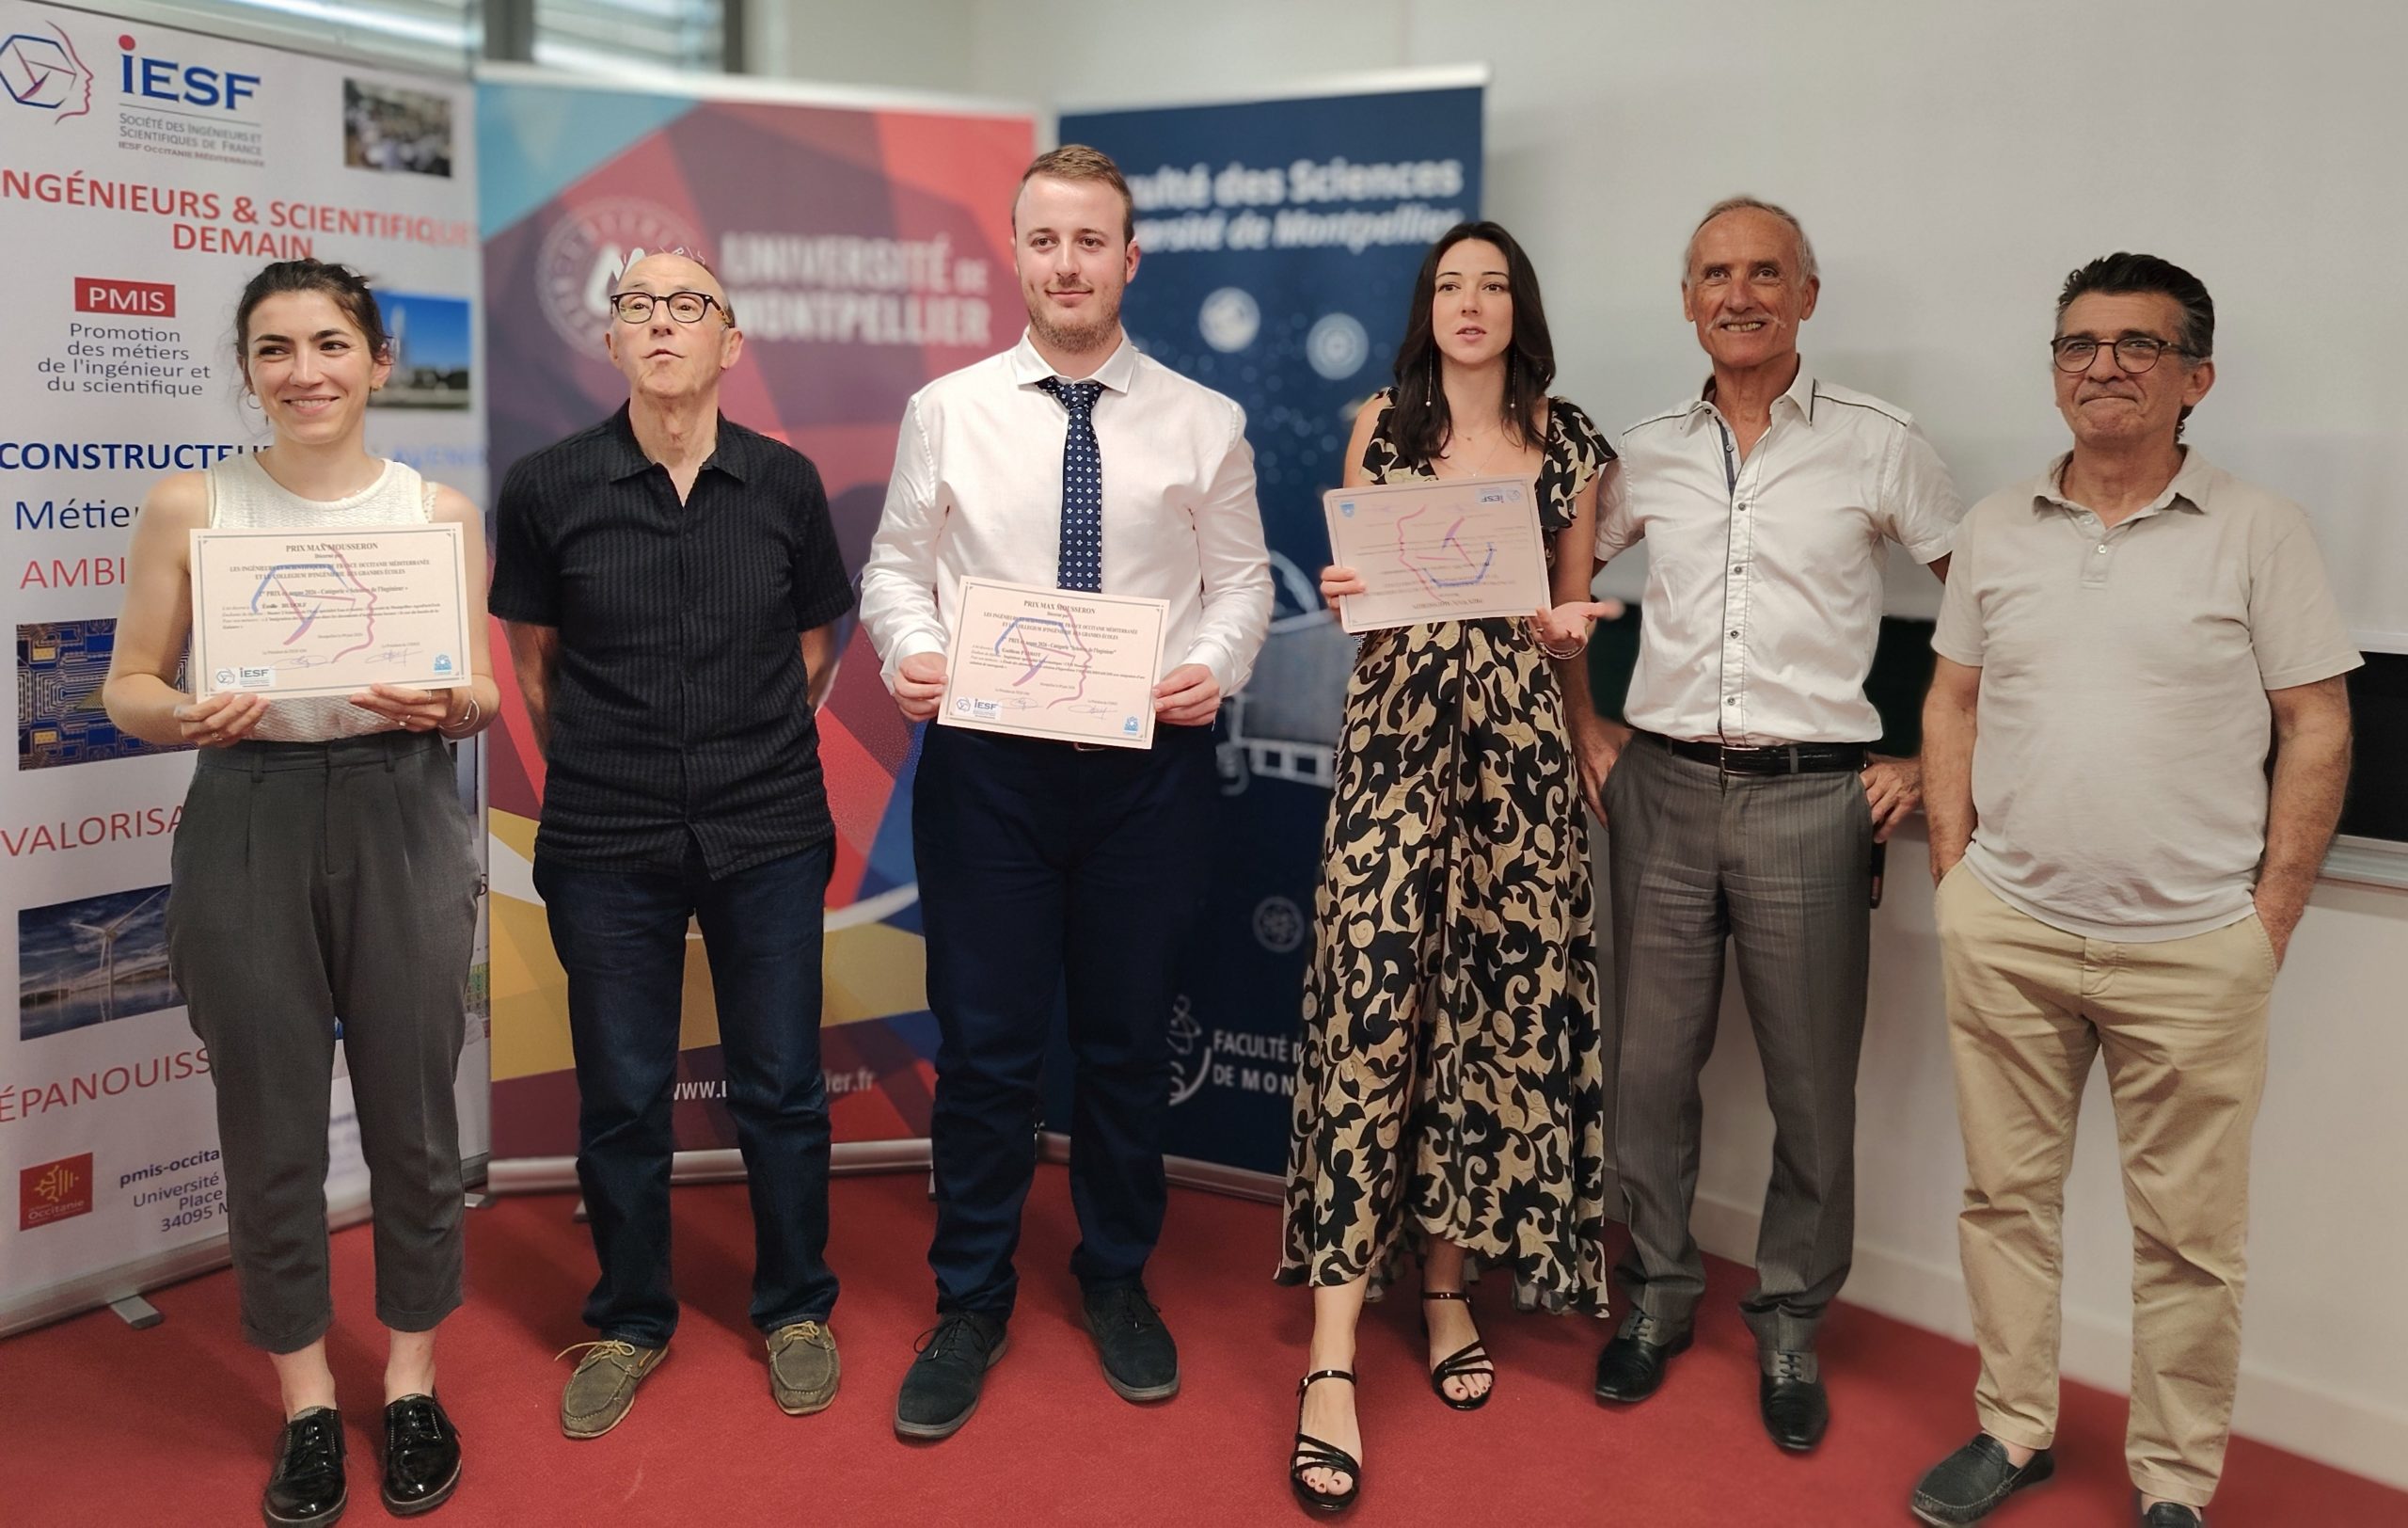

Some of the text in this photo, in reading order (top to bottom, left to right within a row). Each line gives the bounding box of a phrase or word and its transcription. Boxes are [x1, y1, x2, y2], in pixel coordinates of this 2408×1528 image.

[119, 113, 262, 144] SOCIÉTÉ DES INGÉNIEURS ET
[120, 126, 262, 156] SCIENTIFIQUES DE FRANCE
[1289, 156, 1464, 203] Sciences
[2, 169, 221, 220] NGÉNIEURS
[232, 196, 259, 225] &
[173, 223, 314, 261] DEMAIN
[89, 286, 166, 312] PMIS
[70, 323, 181, 342] Promotion
[67, 341, 189, 361] des métiers
[38, 358, 212, 379] de l'ingénieur et
[47, 376, 203, 398] du scientifique
[0, 442, 273, 470] CONSTRUCTE
[286, 545, 306, 553] PRIX
[327, 542, 378, 551] MOUSSERON
[20, 557, 126, 590] AMBI
[1023, 600, 1038, 609] PRIX
[1040, 602, 1054, 611] MAX
[1213, 1028, 1288, 1063] FACULTÉ
[0, 1046, 213, 1123] ÉPANOUISS
[1212, 1063, 1295, 1098] DE MON
[119, 1150, 220, 1189] pmis-occita
[134, 1171, 219, 1208] Université
[179, 1189, 223, 1211] Place
[161, 1205, 213, 1233] 34095
